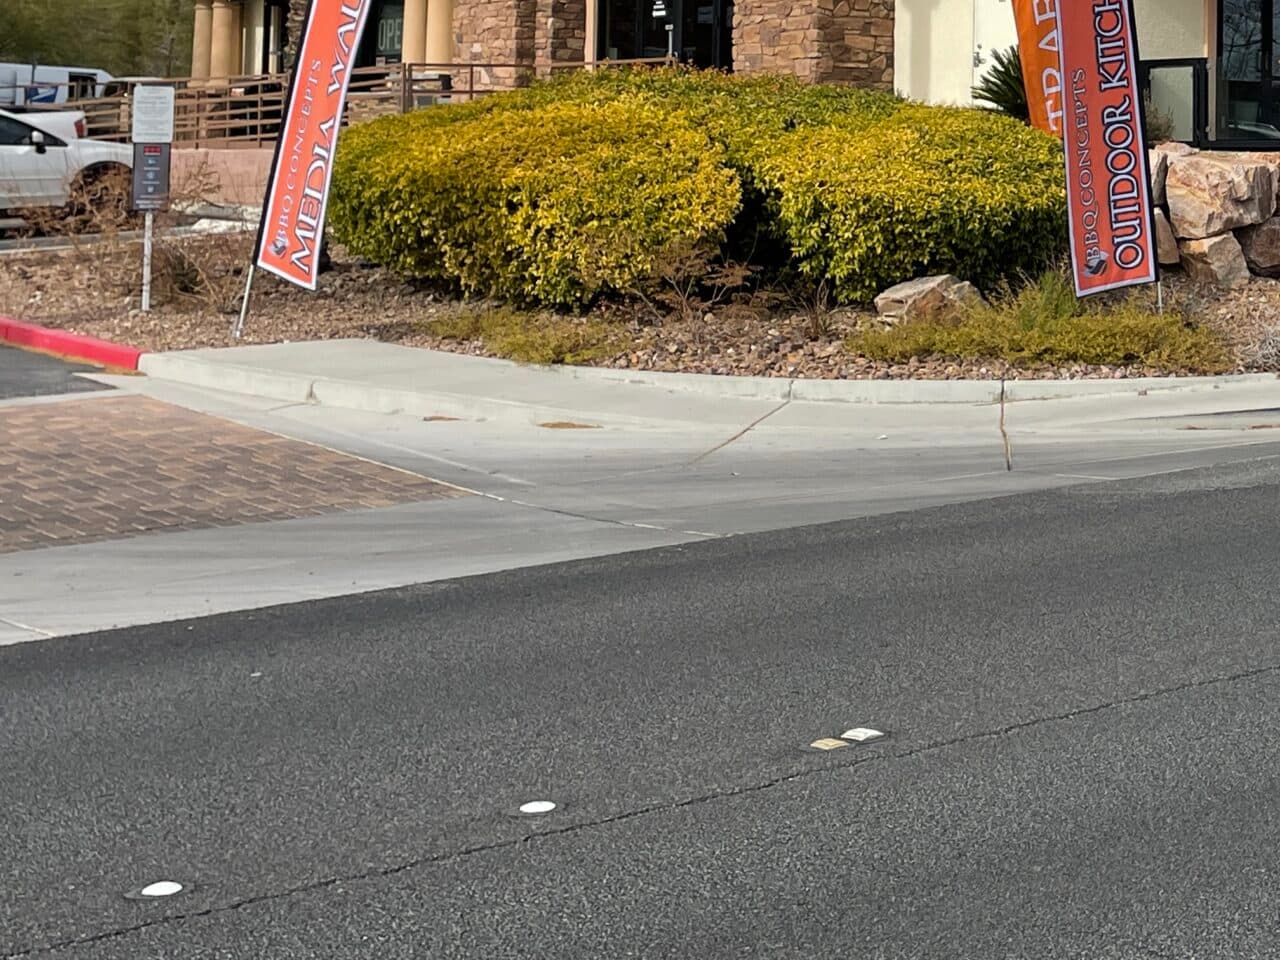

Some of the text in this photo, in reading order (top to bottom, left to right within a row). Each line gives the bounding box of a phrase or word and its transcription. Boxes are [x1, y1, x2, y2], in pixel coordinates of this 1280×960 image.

[378, 18, 402, 51] OPE
[285, 58, 322, 196] CONCEPTS
[290, 119, 335, 276] MEDIA
[1070, 66, 1100, 262] BBQ CONCEPTS
[1101, 95, 1144, 269] OUTDOOR
